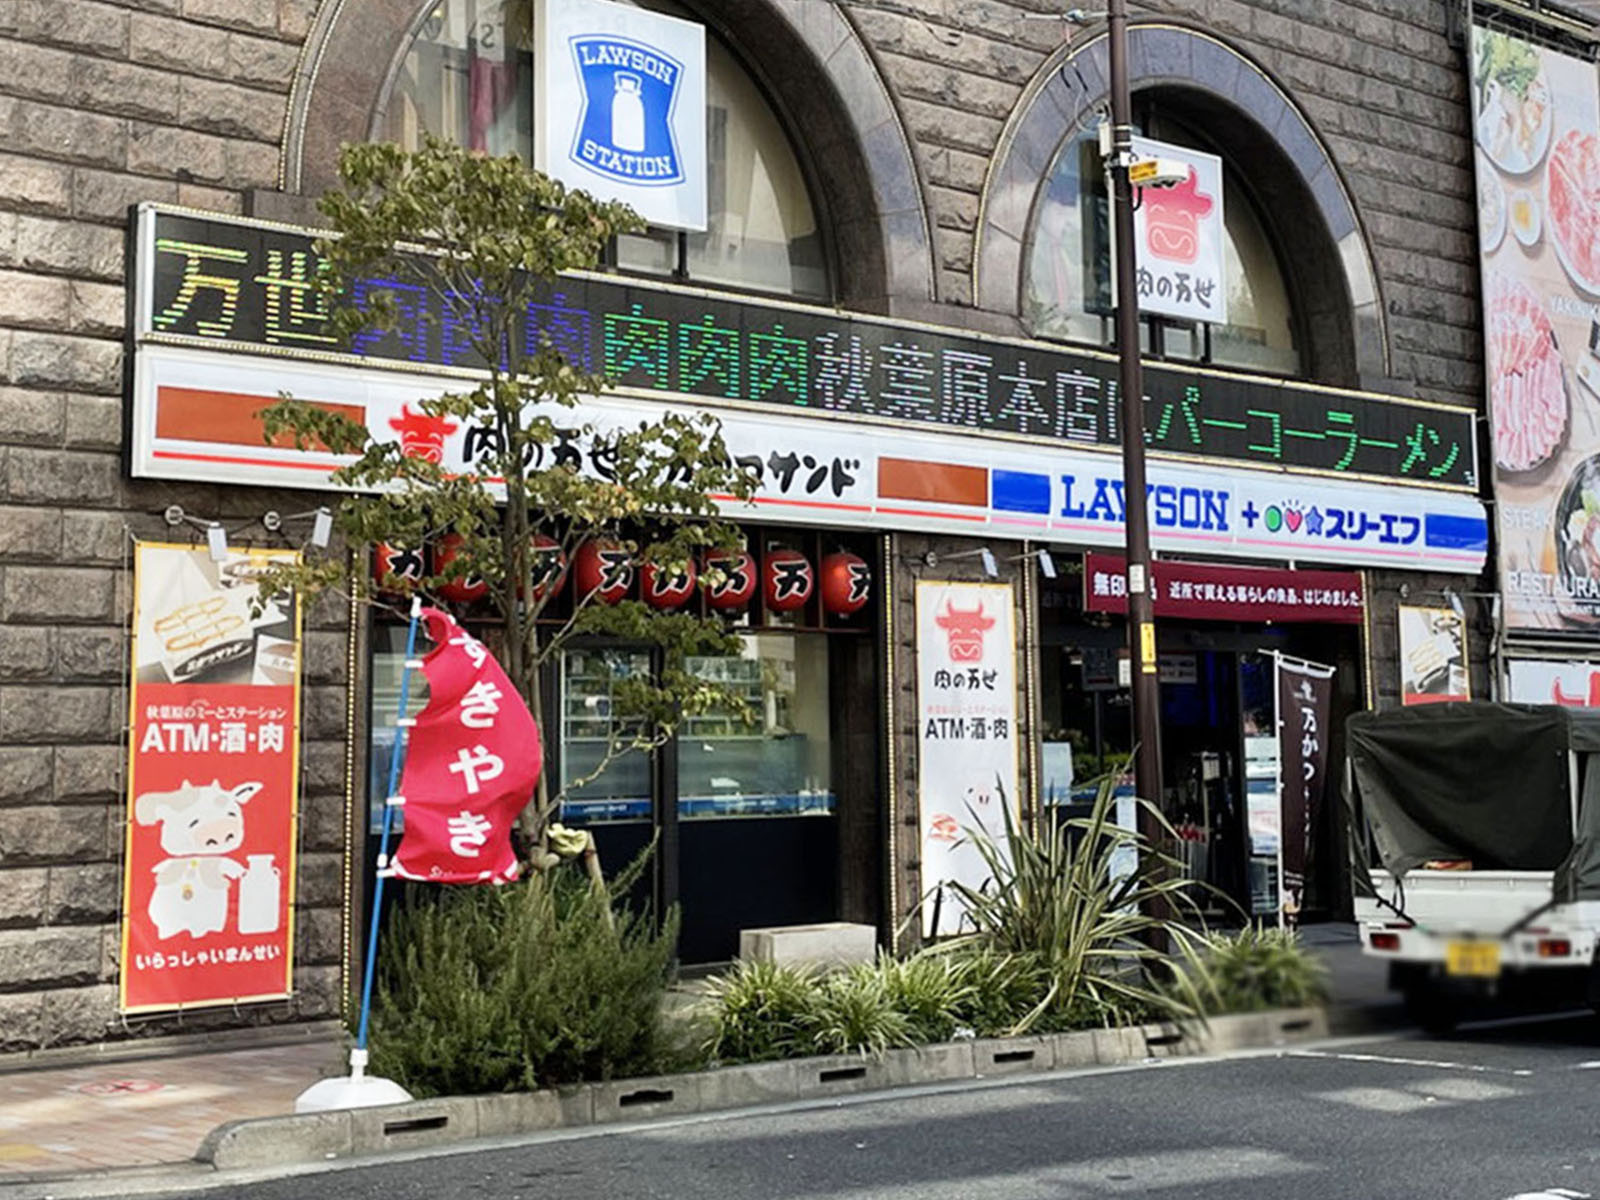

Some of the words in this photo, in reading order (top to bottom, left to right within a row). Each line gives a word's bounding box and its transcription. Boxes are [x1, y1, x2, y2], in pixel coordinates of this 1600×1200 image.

[580, 44, 674, 85] LAWSON
[582, 139, 673, 176] STATION
[1325, 508, 1420, 545] スリーエフ
[706, 556, 748, 598] 万
[772, 561, 809, 601] 万
[139, 721, 285, 753] ATM・酒・肉
[448, 631, 505, 858] すきやき
[925, 717, 1009, 740] ATM・酒・肉
